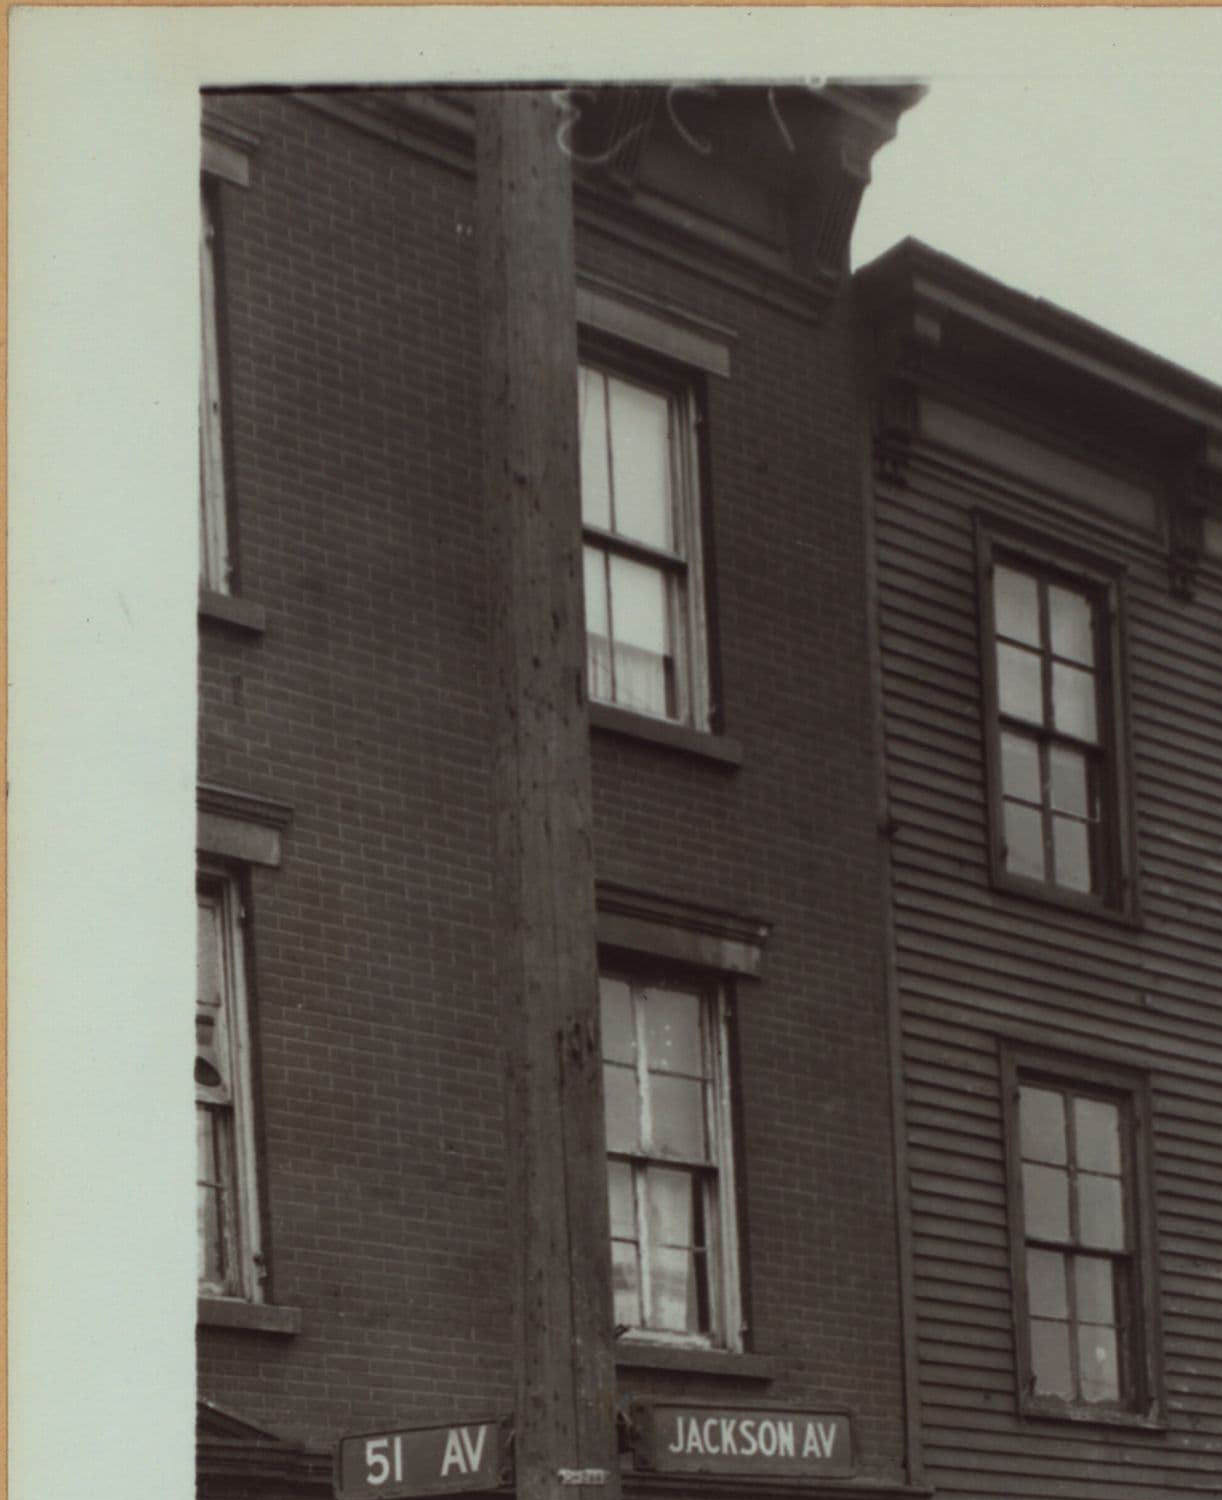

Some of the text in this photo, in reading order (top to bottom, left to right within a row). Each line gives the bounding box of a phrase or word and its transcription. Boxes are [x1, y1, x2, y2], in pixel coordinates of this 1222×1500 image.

[365, 1424, 487, 1486] 51 AV
[668, 1415, 837, 1459] JACKSON AV
